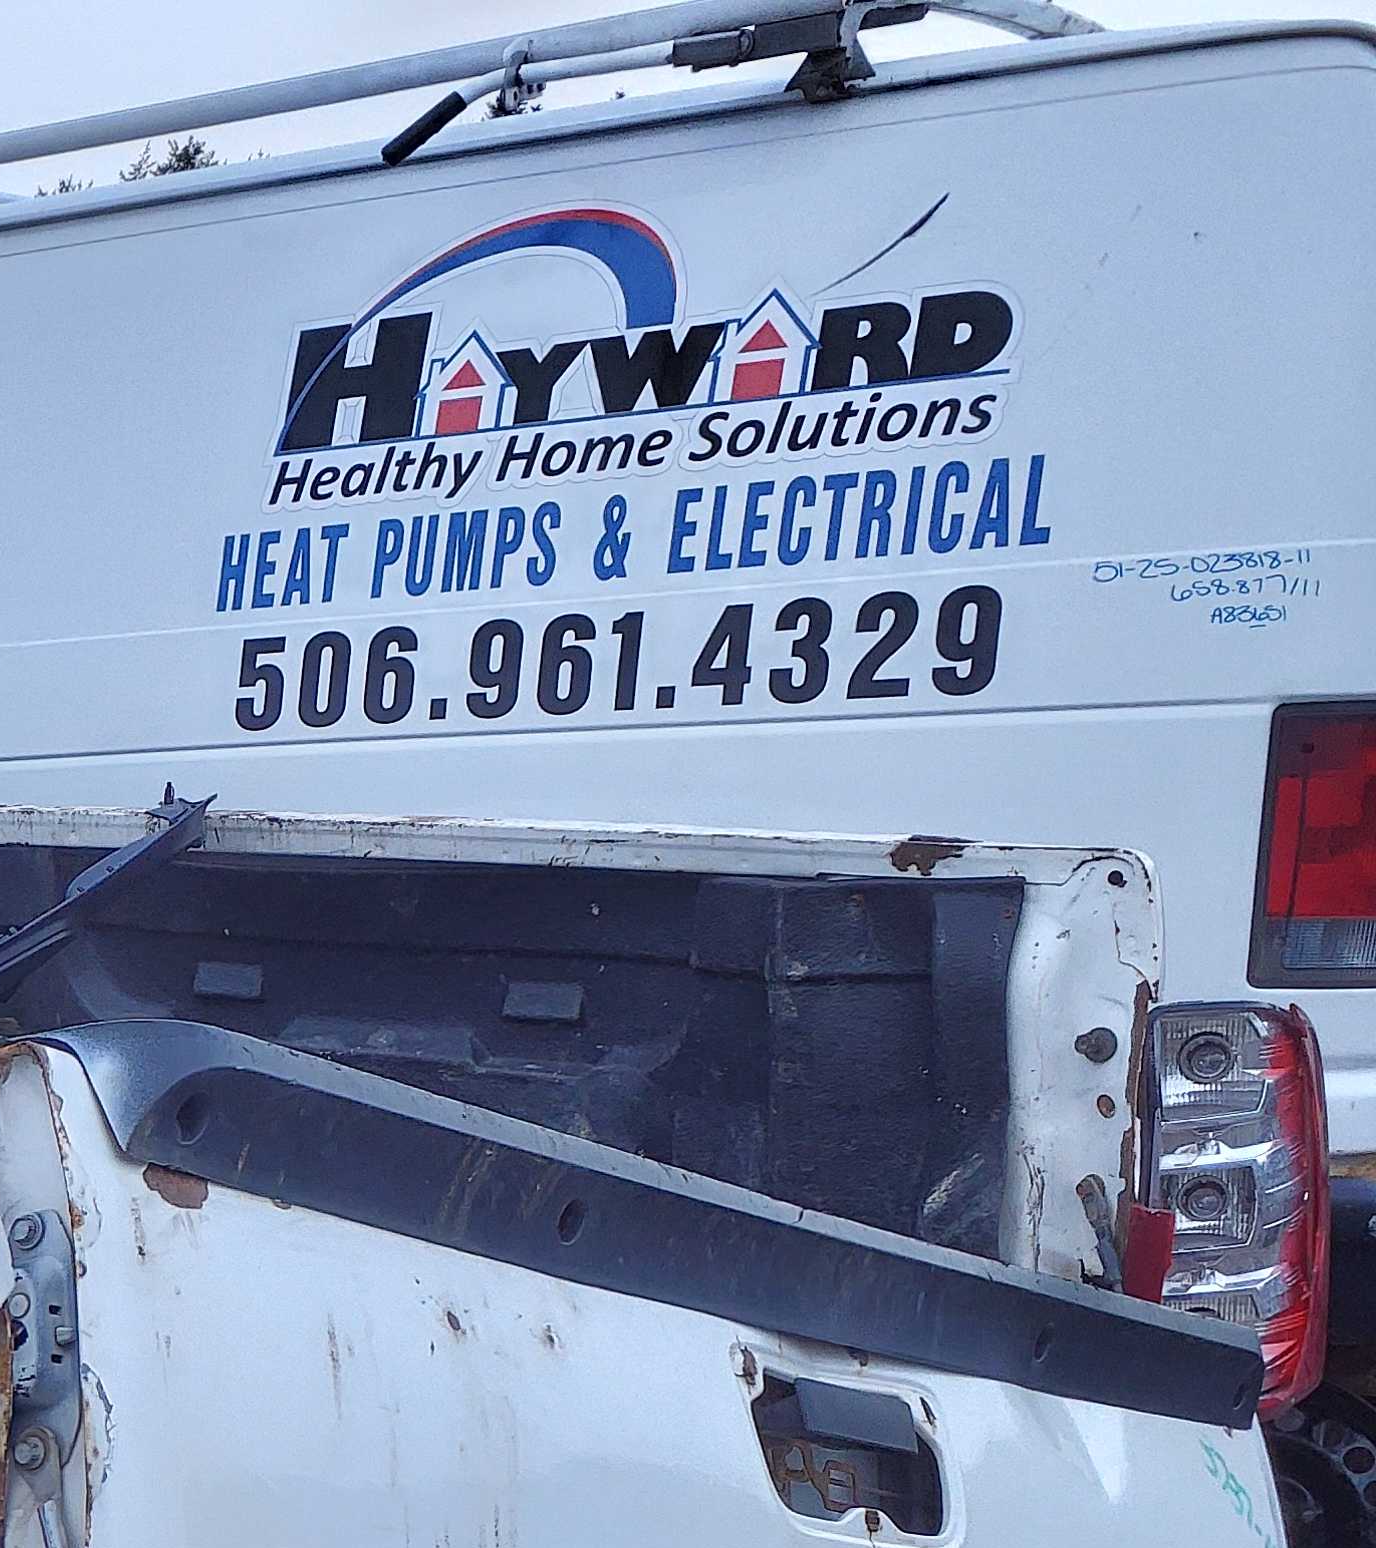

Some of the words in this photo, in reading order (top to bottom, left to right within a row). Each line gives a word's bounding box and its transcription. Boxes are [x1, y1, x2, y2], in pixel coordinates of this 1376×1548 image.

[277, 289, 1015, 453] HAYWARD
[269, 445, 482, 507] Healthy
[496, 429, 673, 484] Home
[689, 393, 998, 461] Solutions
[218, 523, 350, 612] HEAT
[372, 501, 561, 599] PUMPS
[593, 496, 632, 581] &
[668, 455, 1051, 576] ELECTRICAL
[234, 584, 1005, 732] 506.961.4329
